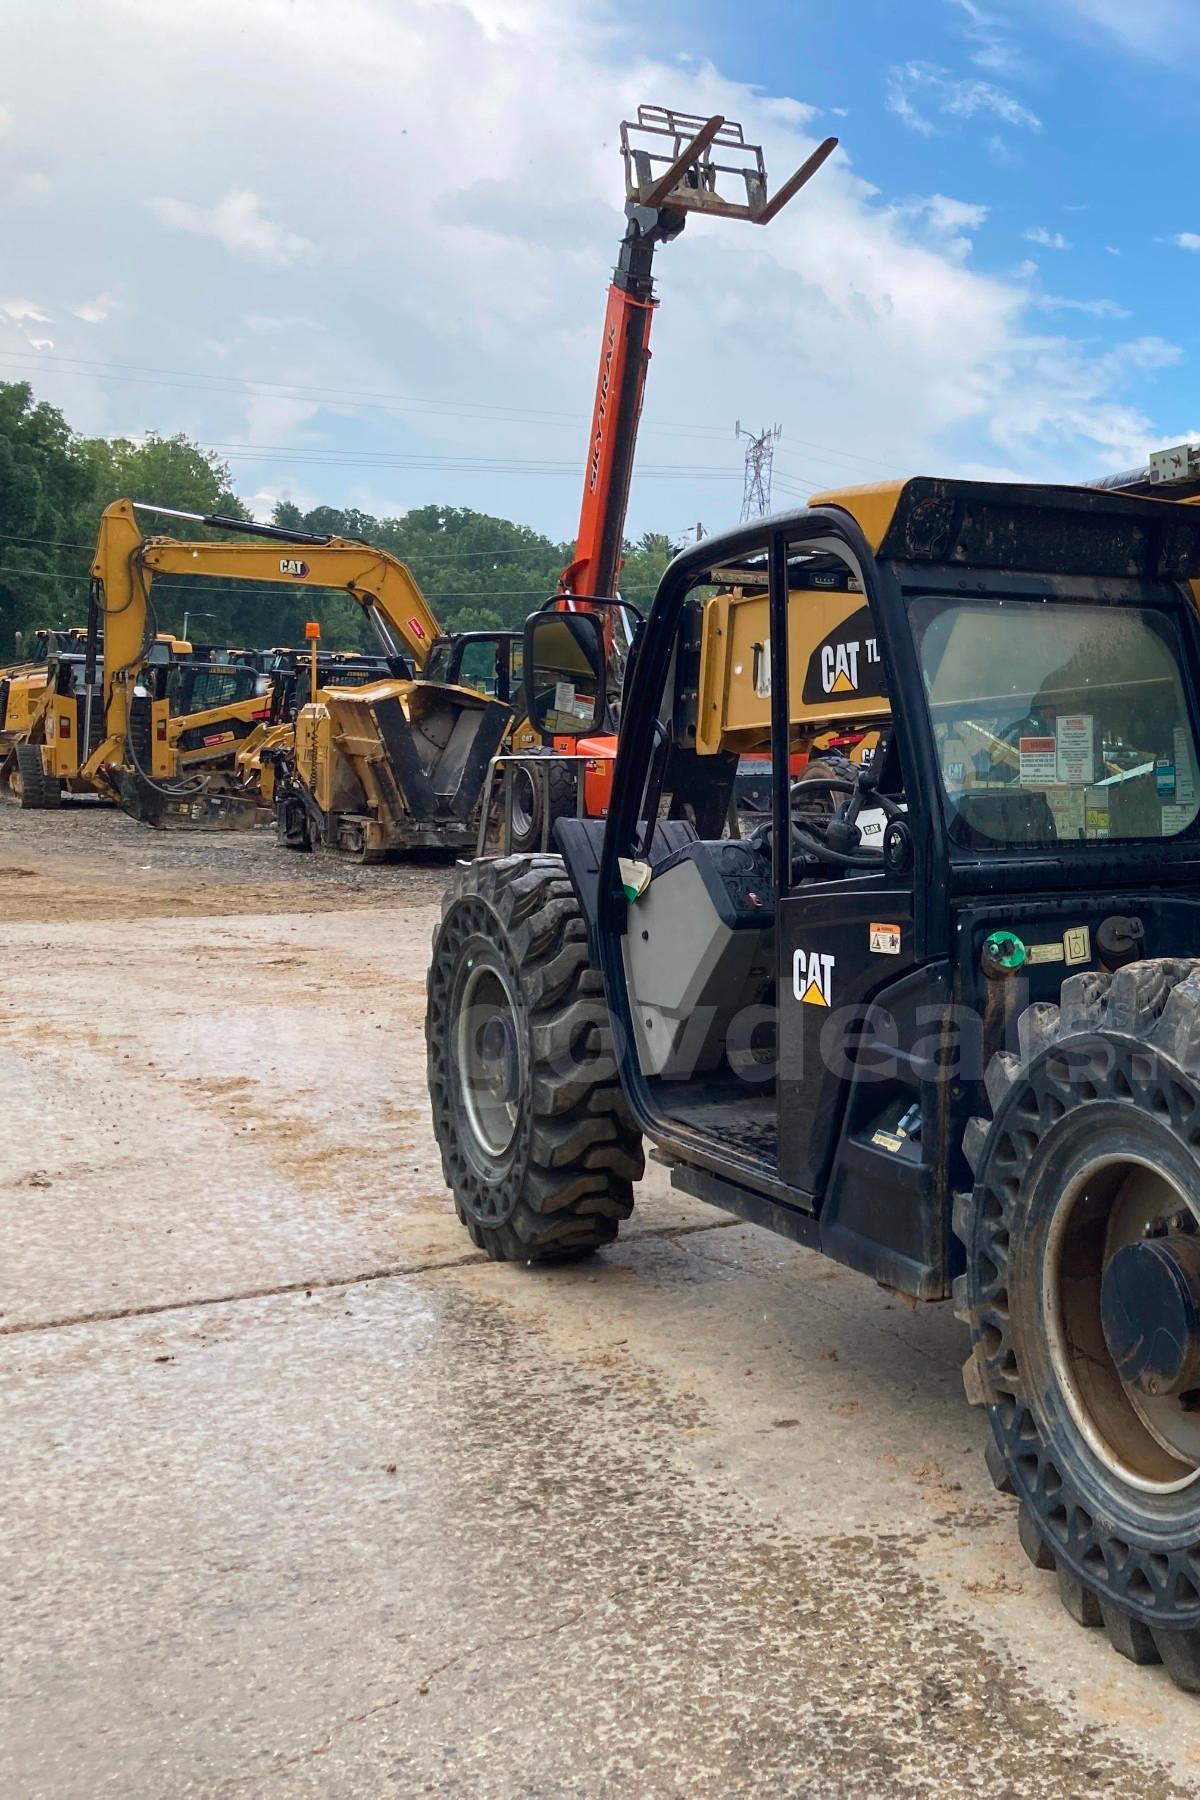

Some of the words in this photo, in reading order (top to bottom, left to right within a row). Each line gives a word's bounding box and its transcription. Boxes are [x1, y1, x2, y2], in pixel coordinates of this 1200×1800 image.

[590, 321, 617, 495] SKYTRAK
[279, 559, 304, 575] CAT
[821, 641, 860, 694] CAT
[793, 949, 836, 1008] CAT
